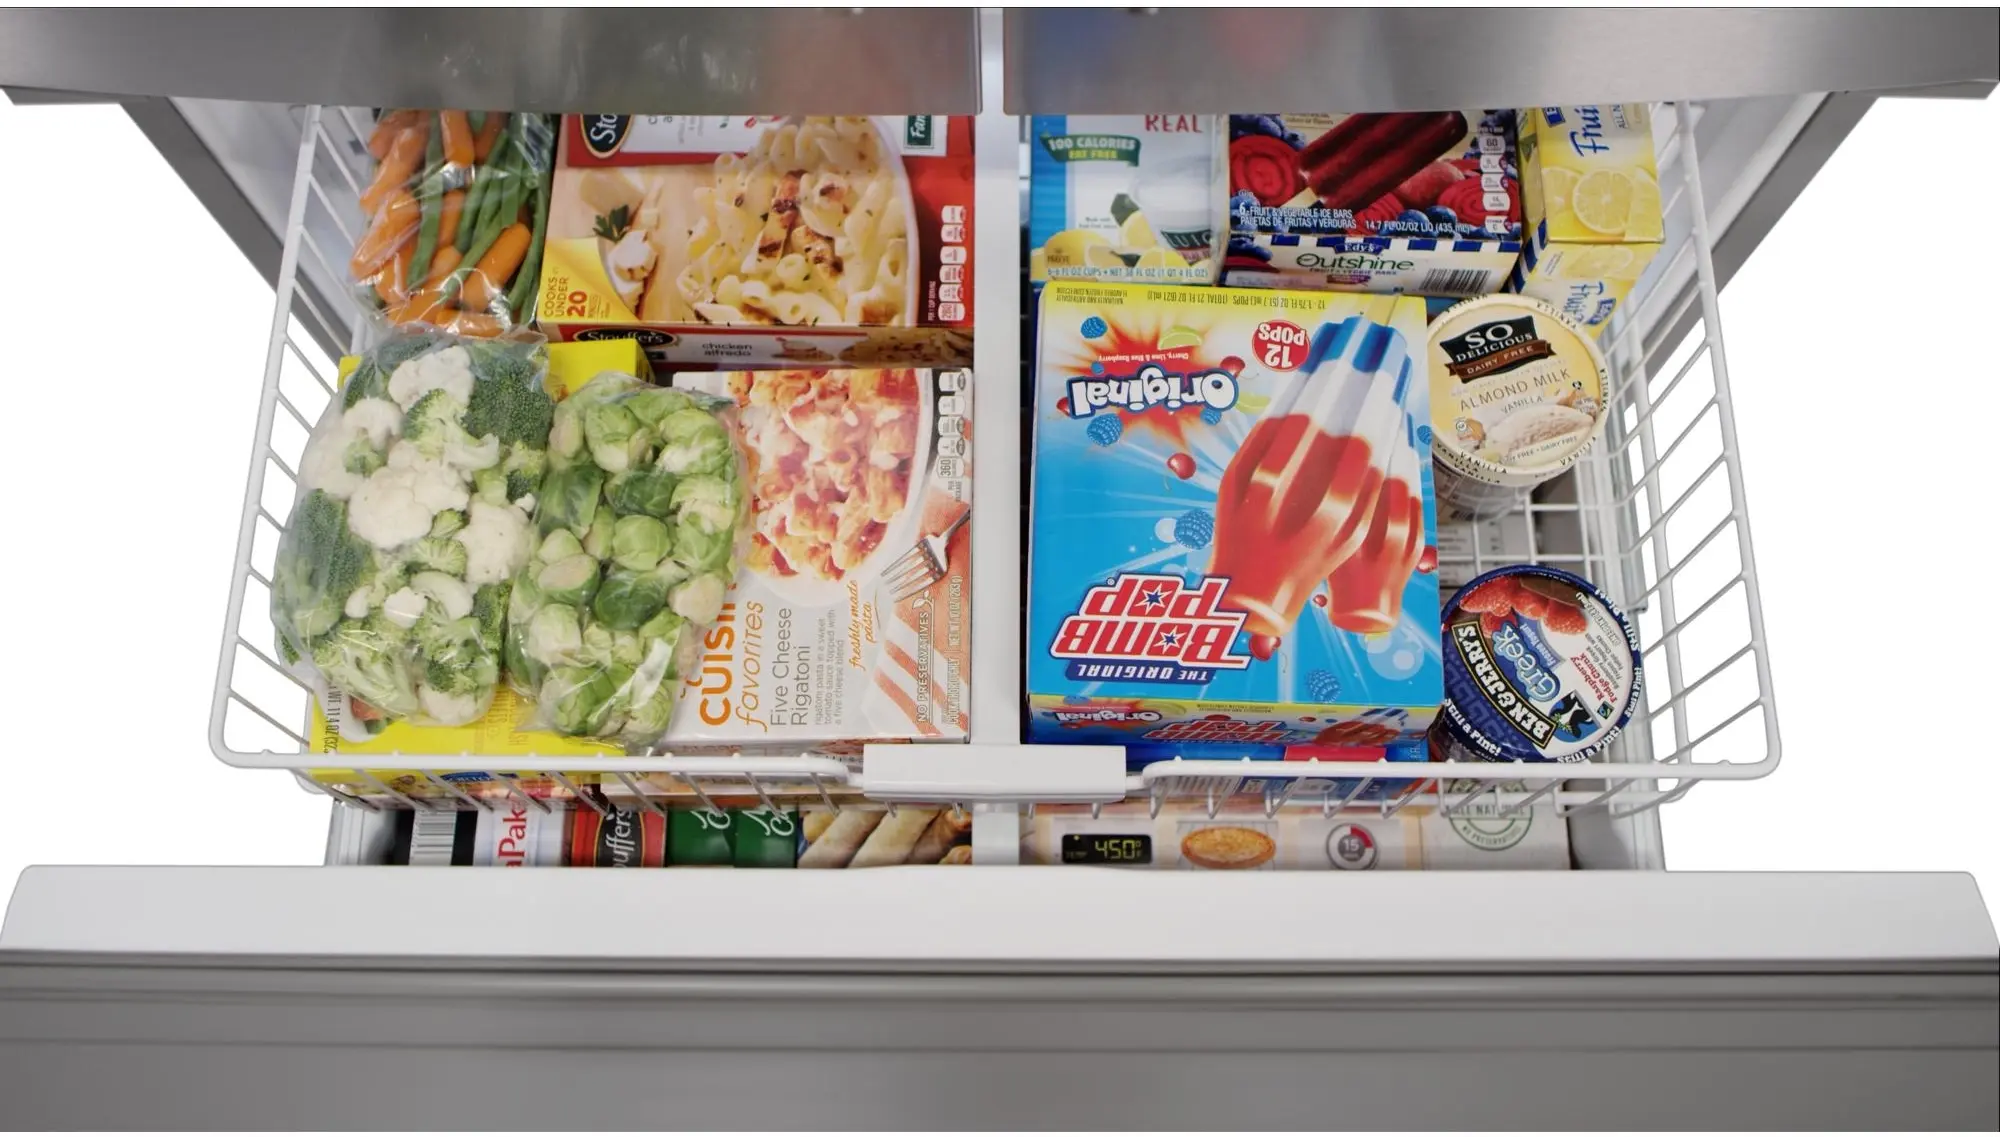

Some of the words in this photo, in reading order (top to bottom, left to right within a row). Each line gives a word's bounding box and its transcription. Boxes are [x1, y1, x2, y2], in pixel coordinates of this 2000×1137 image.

[1047, 137, 1073, 151] 100
[1076, 137, 1136, 150] CALORIES
[1569, 108, 1610, 158] Frui
[1240, 216, 1271, 227] PALETAS
[1273, 217, 1282, 227] DE
[1284, 217, 1311, 228] FRUTAS
[1312, 218, 1318, 228] Y
[1319, 218, 1357, 229] VERDURAS
[1250, 206, 1269, 217] FRUIT
[1279, 207, 1318, 219] VEGETABLE
[1319, 208, 1332, 219] ICE
[1333, 209, 1353, 220] BARS
[1365, 220, 1382, 230] 14.7
[1296, 253, 1415, 271] Outshine
[543, 276, 558, 318] COOKS
[554, 276, 569, 318] UNDER
[566, 290, 588, 318] 20
[1232, 295, 1249, 305] POPS
[1258, 321, 1307, 346] POPS
[1465, 323, 1514, 350] SO
[1099, 353, 1131, 363] Raspberry
[1132, 353, 1144, 361] Blue
[1151, 352, 1164, 361] Lime
[1165, 352, 1189, 361] Cherry,
[1263, 343, 1293, 369] 12
[1455, 332, 1534, 363] DELICIOUS
[1466, 356, 1499, 375] DAIRY
[1503, 345, 1535, 361] FREE
[1070, 365, 1237, 418] Original
[1459, 380, 1529, 412] ALMOND
[1533, 368, 1572, 388] MILK
[1500, 395, 1544, 415] VANILLA
[940, 459, 951, 476] 360
[1459, 451, 1509, 475] VANILLA
[847, 580, 861, 617] made
[1083, 577, 1245, 622] POP
[826, 609, 835, 628] with
[861, 601, 877, 644] pasta
[771, 607, 793, 680] Cheese
[825, 629, 836, 663] topped
[848, 618, 866, 671] freshly
[1052, 617, 1250, 667] BOMB
[1519, 622, 1541, 646] Yogurt
[699, 582, 737, 726] CUISI
[835, 639, 844, 665] blend
[917, 612, 929, 702] PRESERVATIVES
[1458, 625, 1506, 699] JERRY'S
[1500, 623, 1558, 699] Greek
[1536, 639, 1556, 666] Frozen
[1580, 652, 1601, 679] Chunk
[790, 645, 812, 726] Rigatoni
[815, 664, 825, 690] pasta
[826, 664, 834, 690] sauce
[834, 667, 843, 699] cheese
[1077, 664, 1174, 680] ORIGINAL
[1177, 669, 1209, 682] THE
[1571, 655, 1606, 701] Raspberry
[1499, 689, 1516, 708] &
[1599, 678, 1618, 704] Fudge
[770, 685, 789, 726] Five
[815, 690, 825, 726] rigatoni
[823, 692, 833, 725] tomato
[833, 701, 842, 718] five
[917, 704, 928, 722] NO
[1057, 710, 1161, 723] Original
[1509, 696, 1551, 740] BEN
[1444, 699, 1465, 727] Still
[1470, 729, 1501, 756] Pint!
[1593, 726, 1622, 753] Pint!
[1344, 840, 1360, 851] 15
